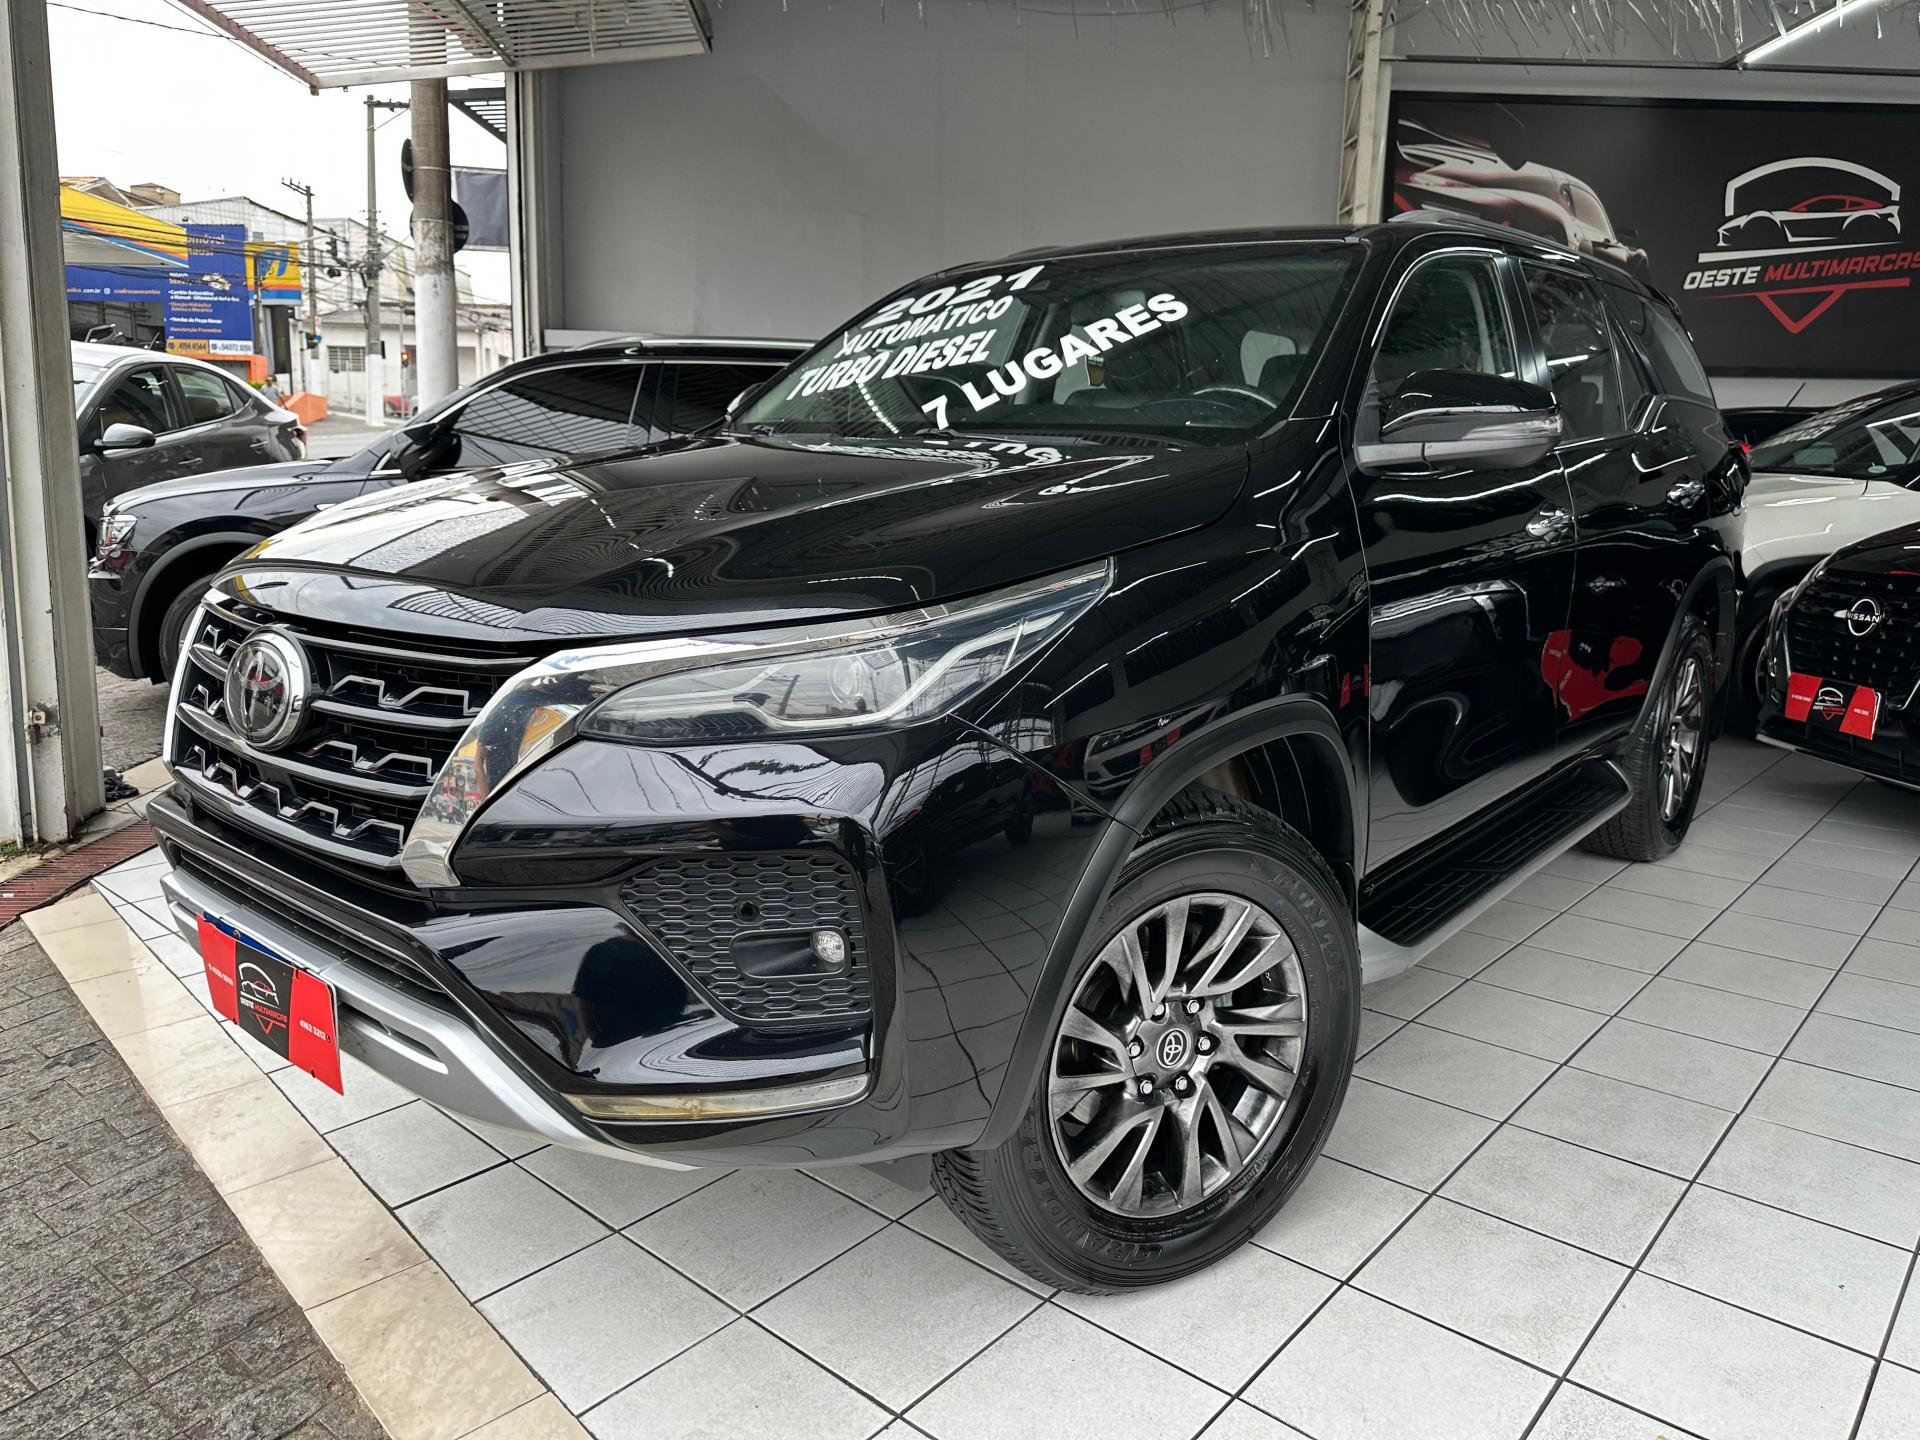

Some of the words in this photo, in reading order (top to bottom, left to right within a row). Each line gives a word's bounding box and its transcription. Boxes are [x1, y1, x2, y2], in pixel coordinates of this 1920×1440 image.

[863, 265, 1045, 328] 2021
[1683, 266, 1761, 290] OESTE
[1764, 251, 1920, 283] MULTIMARCAS
[834, 295, 1013, 359] AUTOMÁTICO
[787, 348, 885, 400] TURBO
[881, 328, 997, 380] DIESEL
[921, 395, 948, 430] 7
[961, 293, 1190, 412] LUGARES
[1846, 611, 1880, 622] NISSAN
[1020, 1108, 1164, 1264] GRANDTRE
